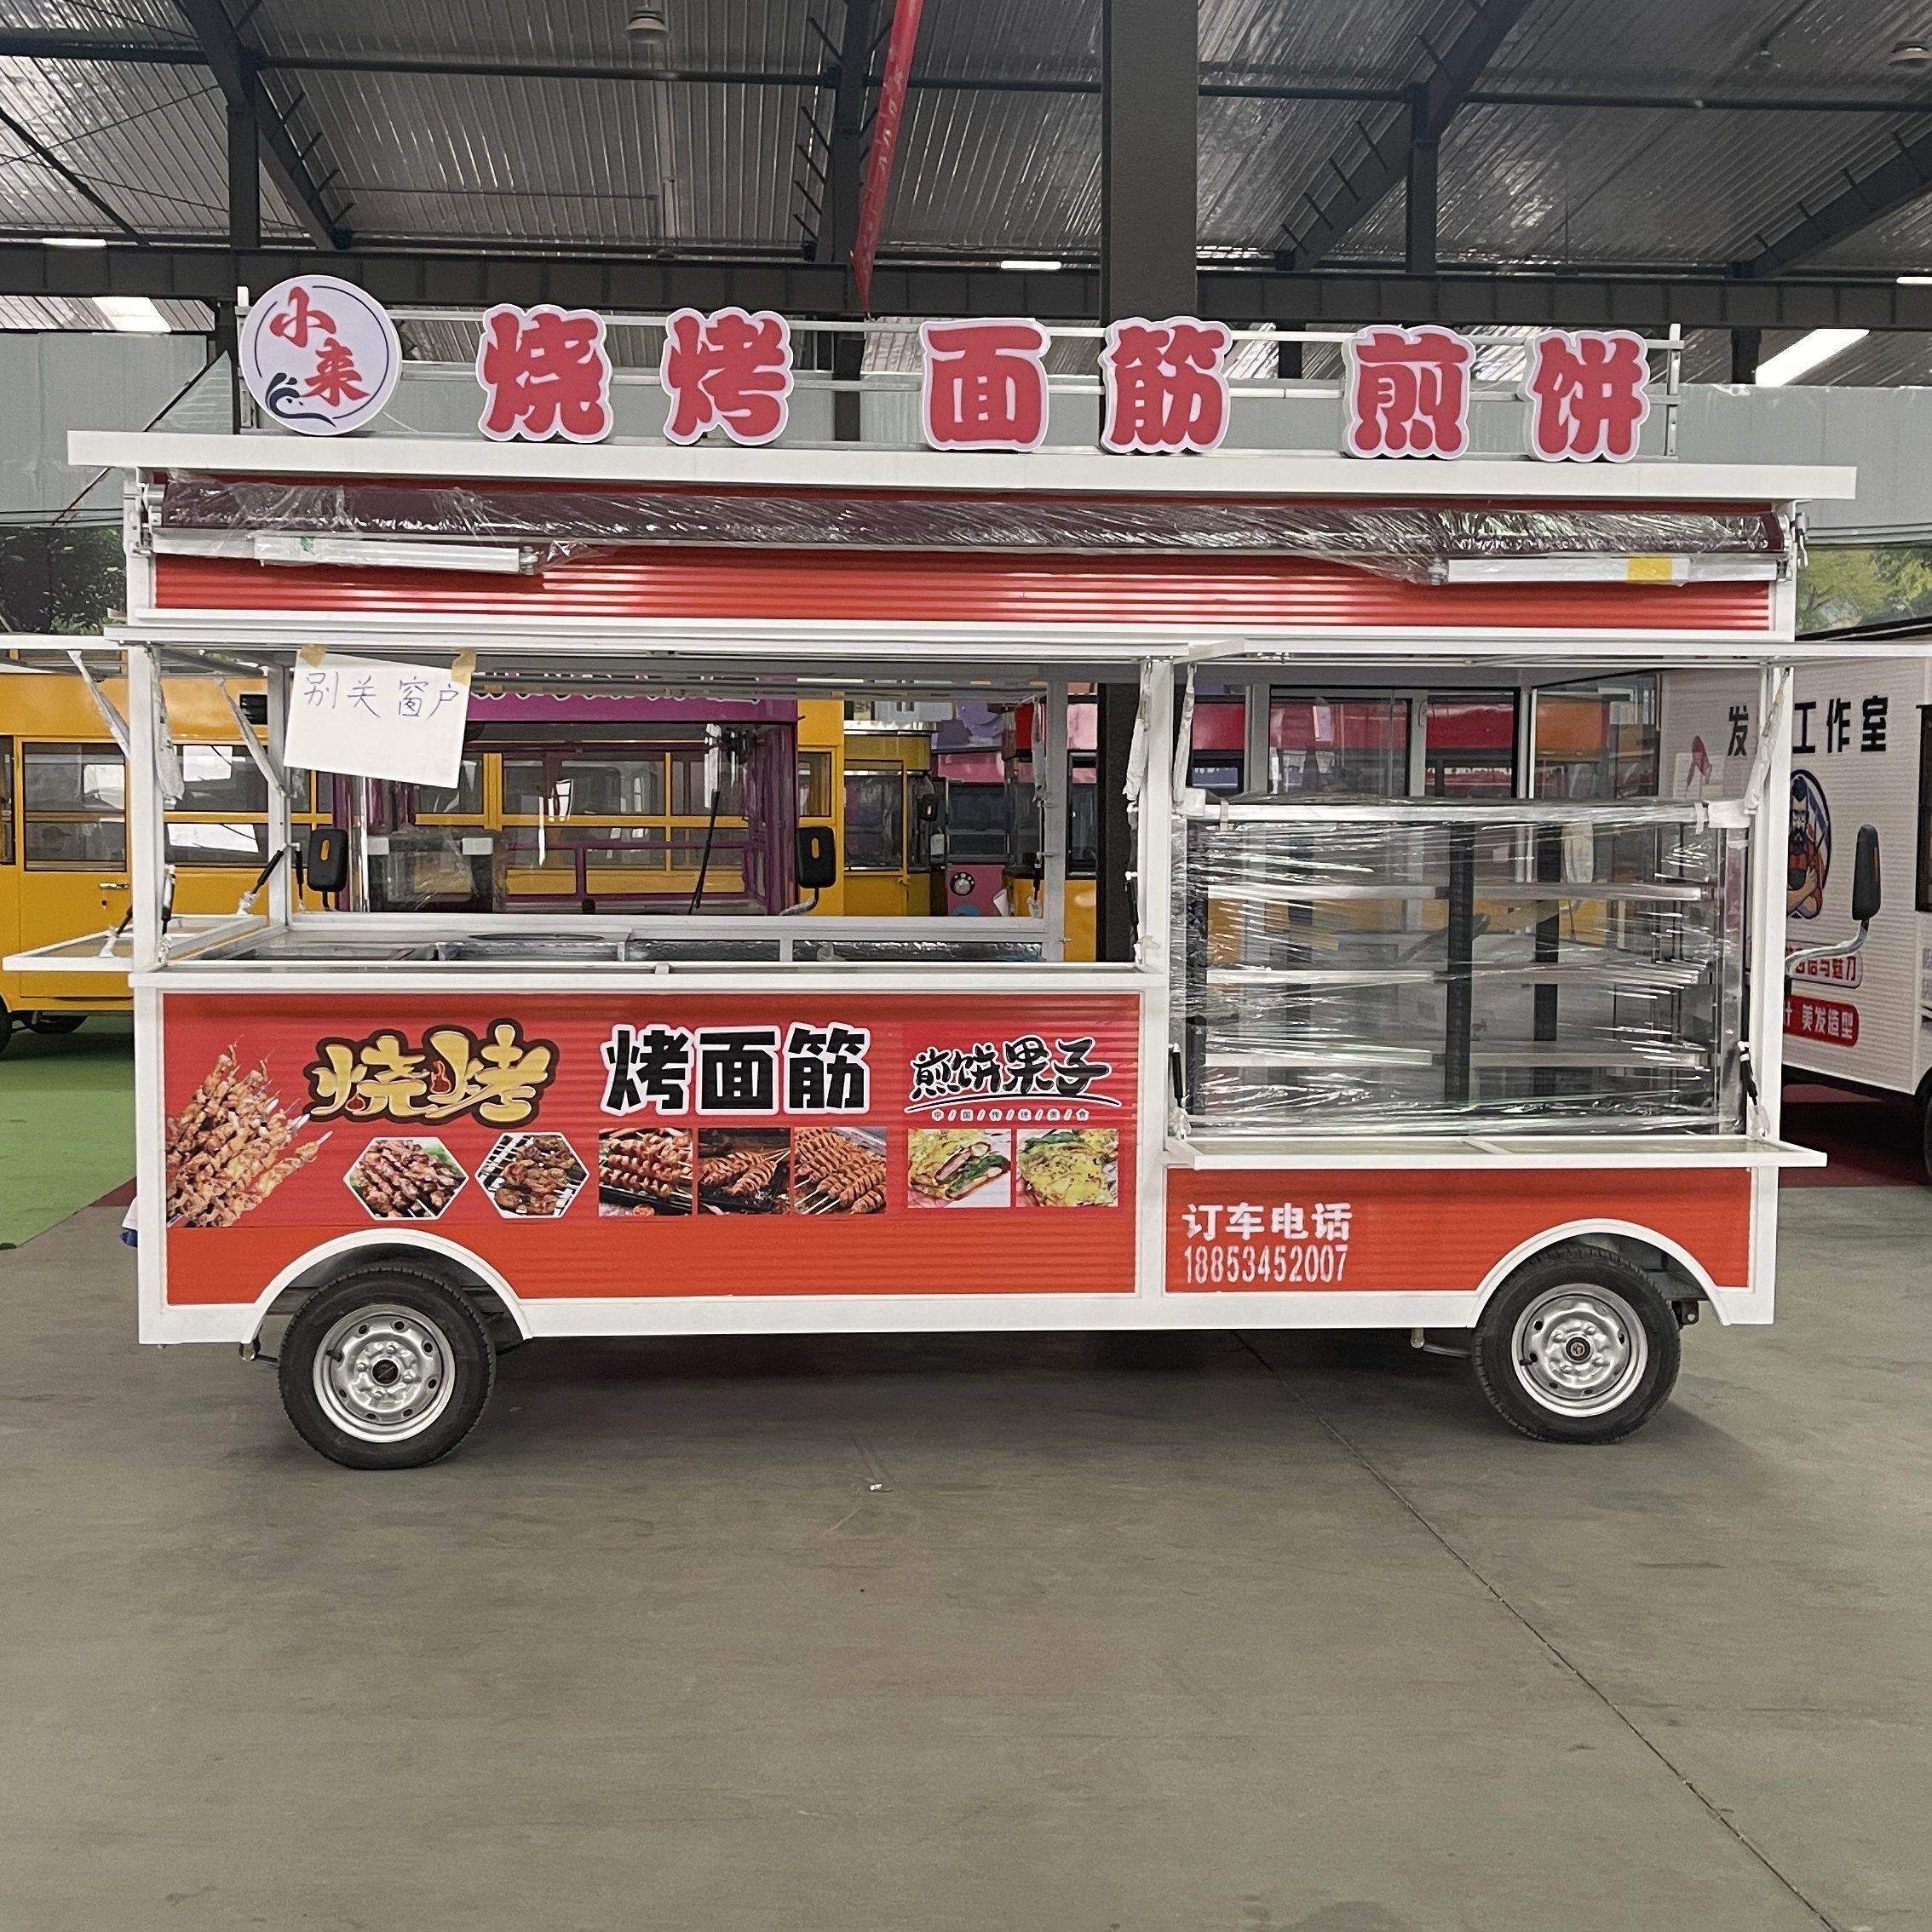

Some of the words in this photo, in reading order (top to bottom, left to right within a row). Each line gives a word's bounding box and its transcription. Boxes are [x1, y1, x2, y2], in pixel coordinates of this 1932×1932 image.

[268, 285, 371, 407] 小来
[481, 309, 790, 438] 烧烤
[924, 322, 1226, 448] 面筋
[1354, 331, 1644, 457] 煎饼
[303, 670, 459, 718] 别关窗户
[1728, 694, 1889, 757] 发工作室
[308, 1021, 555, 1125] 烧烤
[604, 1025, 868, 1113] 烤面筋
[910, 1036, 1112, 1101] 煎饼果子
[1182, 1202, 1353, 1241] 订车电话
[1183, 1244, 1348, 1284] 18853452007
